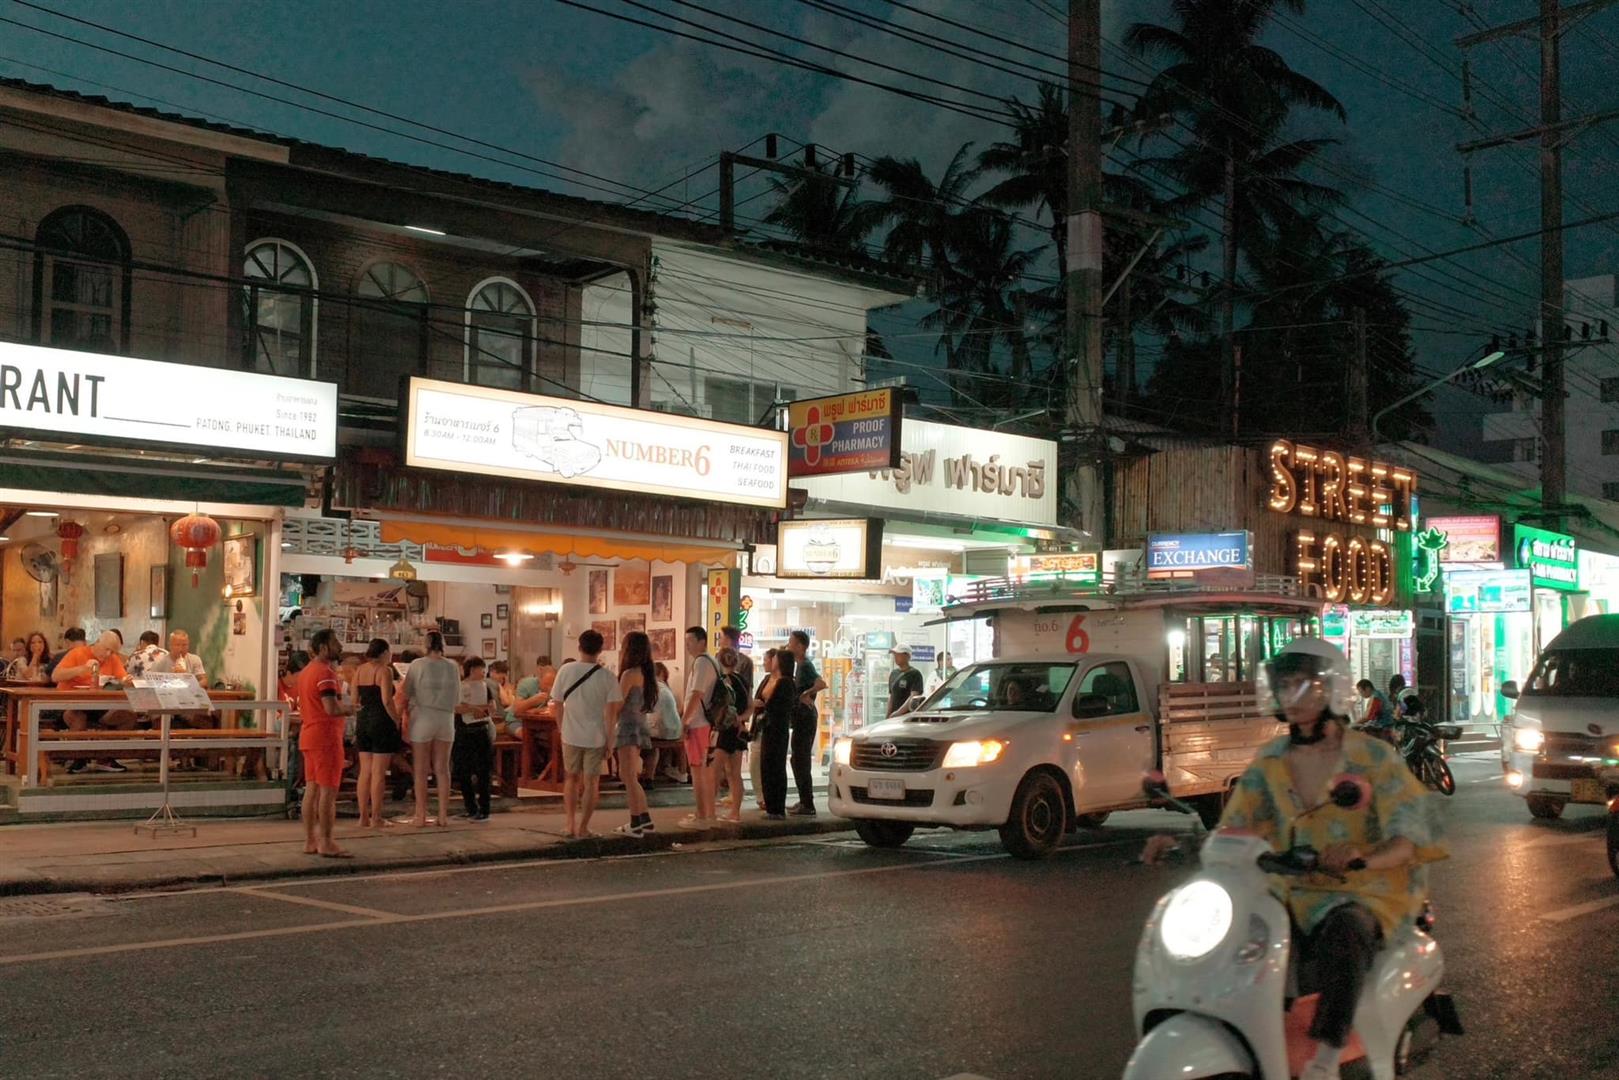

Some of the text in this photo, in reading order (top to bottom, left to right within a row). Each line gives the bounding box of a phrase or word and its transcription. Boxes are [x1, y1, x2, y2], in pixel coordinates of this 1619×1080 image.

[276, 409, 297, 420] Since
[275, 426, 317, 440] THAILAND
[493, 424, 500, 433] 6
[853, 418, 885, 434] PROOF
[729, 445, 775, 459] BREAKFAST
[831, 436, 885, 453] PHARMACY
[732, 461, 775, 474] THAI FOOD
[737, 478, 774, 490] SEAFOOD
[1270, 439, 1416, 529] STREET
[1153, 548, 1241, 565] EXCHANGE
[1298, 529, 1393, 604] FOOD
[1066, 615, 1090, 653] 6
